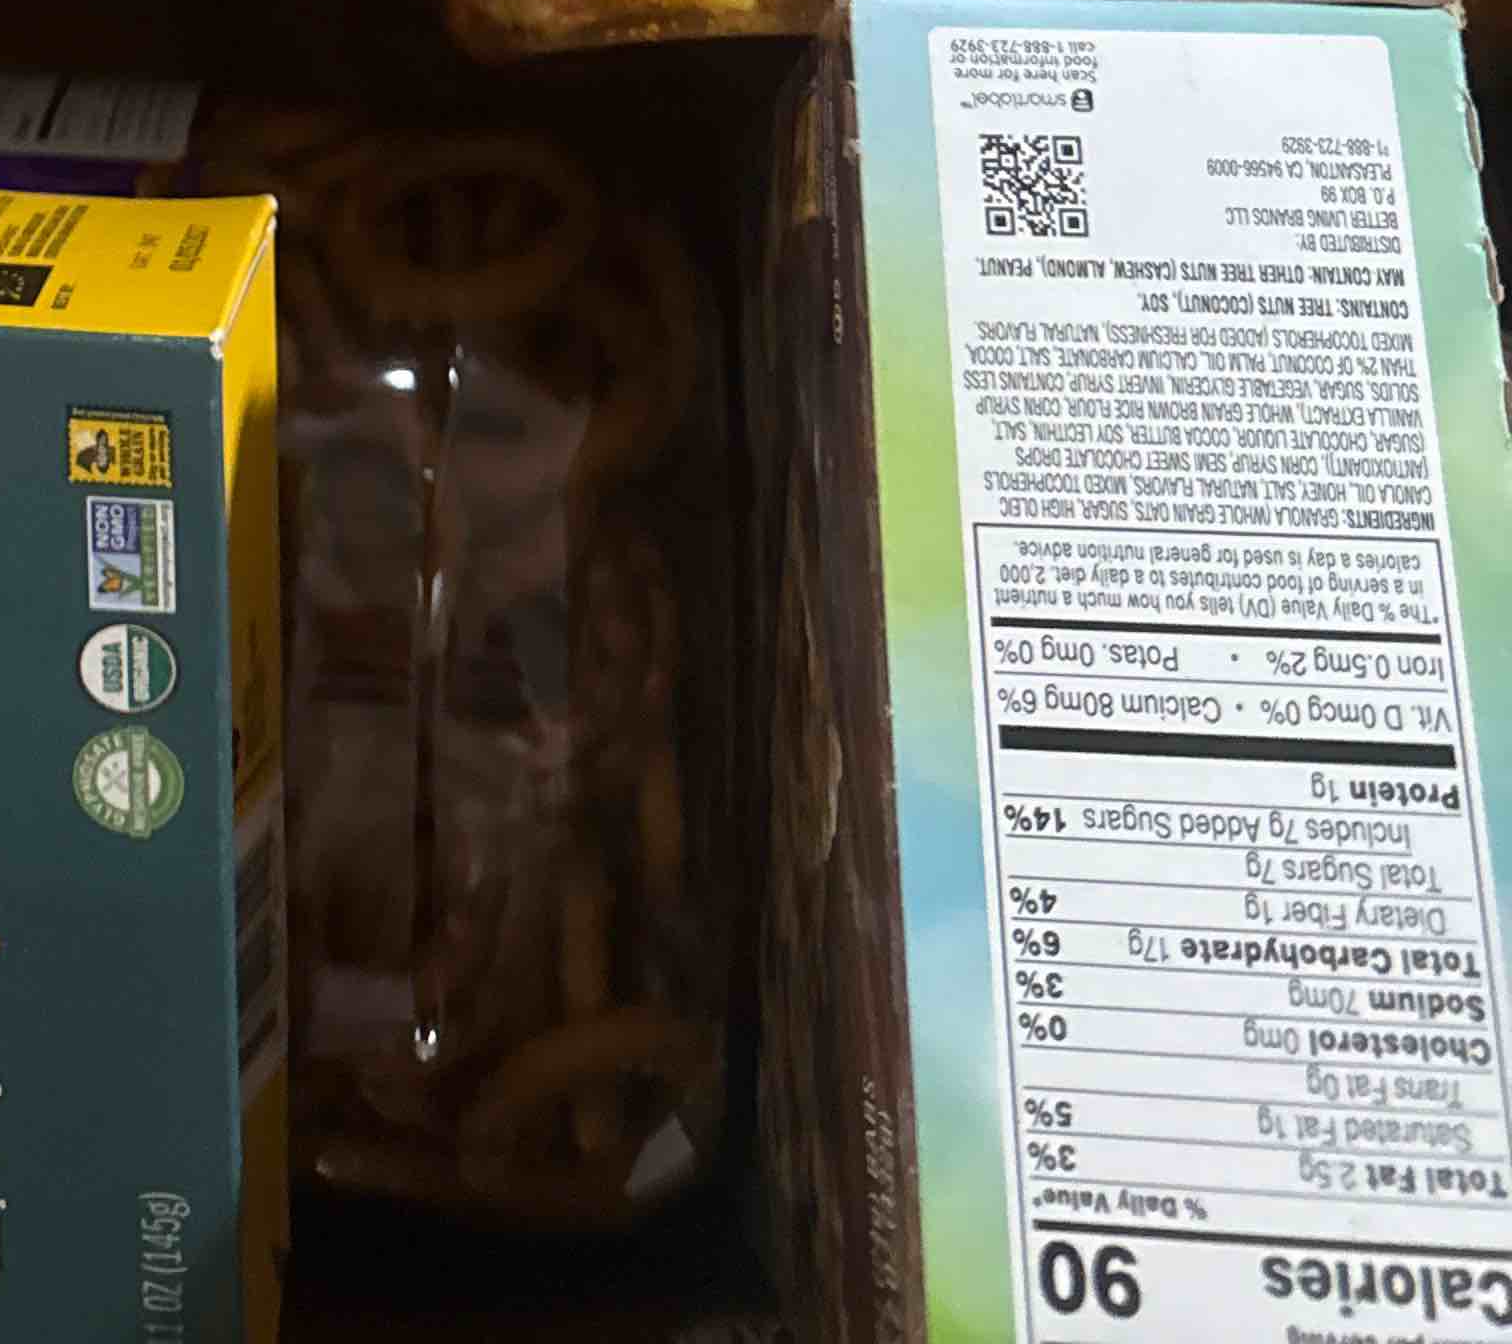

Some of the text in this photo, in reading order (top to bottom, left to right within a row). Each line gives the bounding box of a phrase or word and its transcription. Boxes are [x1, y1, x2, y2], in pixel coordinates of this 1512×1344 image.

[948, 53, 1097, 68] food information or
[1067, 40, 1095, 54] call
[953, 67, 1096, 83] Scan here for more
[1285, 160, 1303, 178] CA
[1304, 159, 1392, 180] PLEASANTON,
[1319, 185, 1395, 205] P.O. BOX 99
[1224, 207, 1398, 229] BETTER LIVING BRANDS LLC
[1294, 233, 1401, 253] DISTRIBUTED BY:
[975, 254, 1404, 286] MAY CONTAIN: OTHER TREE NUTS (CASHEW, ALMOND), PEANUT.
[1136, 289, 1408, 319] CONTAINS: TREE NUTS (COCONUT), SOY.
[95, 503, 109, 548] NON
[110, 503, 125, 549] GMO
[999, 496, 1434, 530] INGREDIENTS: GRANOLA (WHOLE GRAIN OATS, SUGAR, HIGH OLEIC
[994, 587, 1056, 608] nutrient
[1061, 590, 1070, 603] a
[1077, 590, 1121, 611] much
[1128, 592, 1158, 613] how
[1163, 589, 1194, 608] you
[1199, 594, 1233, 615] tells
[1238, 593, 1277, 617] (DV)
[1281, 598, 1327, 619] Value
[1332, 596, 1374, 621] Daily
[1379, 602, 1394, 621] %
[994, 635, 1444, 680] Iron 0.5mg 2% Potas. 0mg 0%
[997, 684, 1451, 732] Vit. D 0mcg 0% Calcium 80mg 6%
[1309, 772, 1460, 809] Protein 1g
[1003, 803, 1411, 849] Includes 7g Added Sugars 14%
[1244, 852, 1440, 892] Total Sugars 7g
[1009, 886, 1446, 933] Dietary Fiber 1g 4%
[1012, 928, 1480, 978] Total Carbohydrate 17g 6%
[1015, 970, 1486, 1021] Sodium 70mg 3%
[1018, 1011, 1491, 1064] Cholesterol 0mg 0%
[1305, 1065, 1461, 1106] Trans Fat 0g
[1025, 1098, 1472, 1150] Saturated Fat 1g 5%
[1027, 1141, 1507, 1198] Total Fat 2.5g 3%
[1117, 1190, 1176, 1217] Daily
[138, 1191, 190, 1271] (145g)
[1037, 1240, 1141, 1320] 90
[1258, 1257, 1512, 1329] Calories
